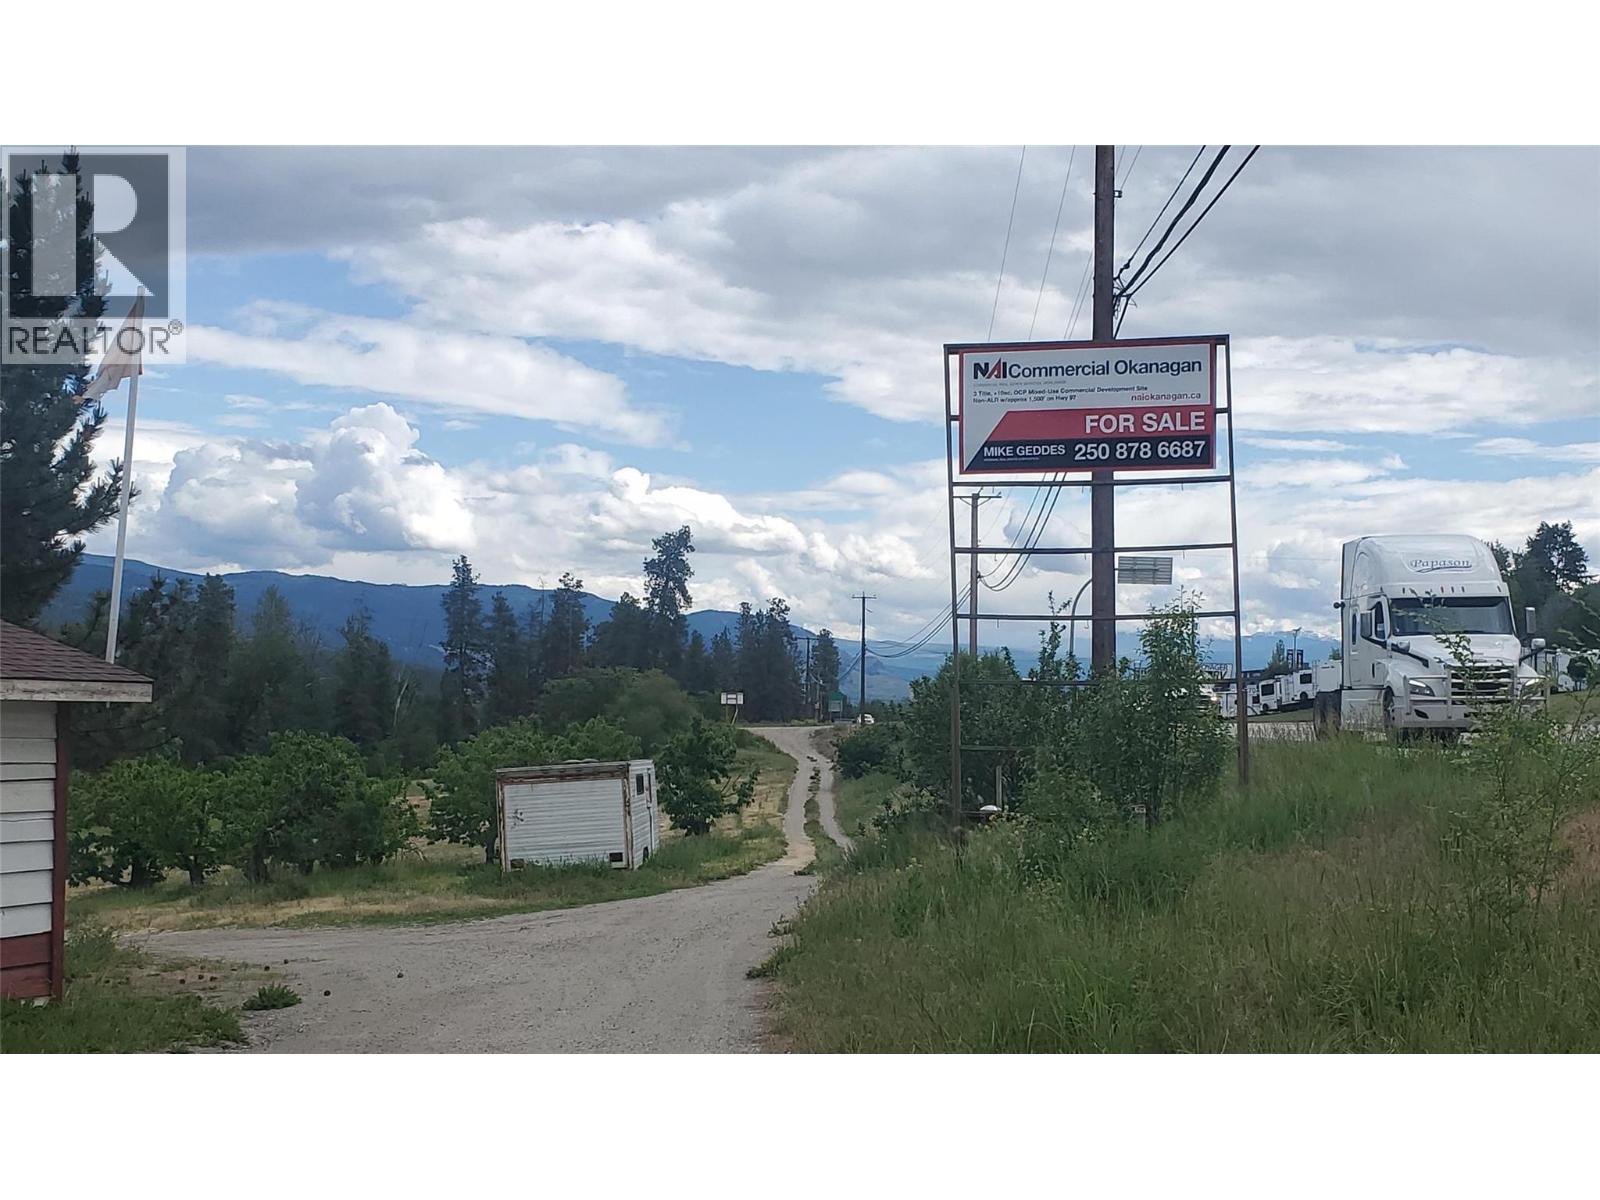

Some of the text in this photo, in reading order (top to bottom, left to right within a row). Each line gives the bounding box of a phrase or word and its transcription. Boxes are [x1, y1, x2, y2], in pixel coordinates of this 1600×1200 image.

[973, 357, 1202, 379] NAI Commercial Okanagan
[1085, 411, 1205, 434] FOR SALE
[983, 440, 1206, 460] MIKE GEDDES 250 878 6687
